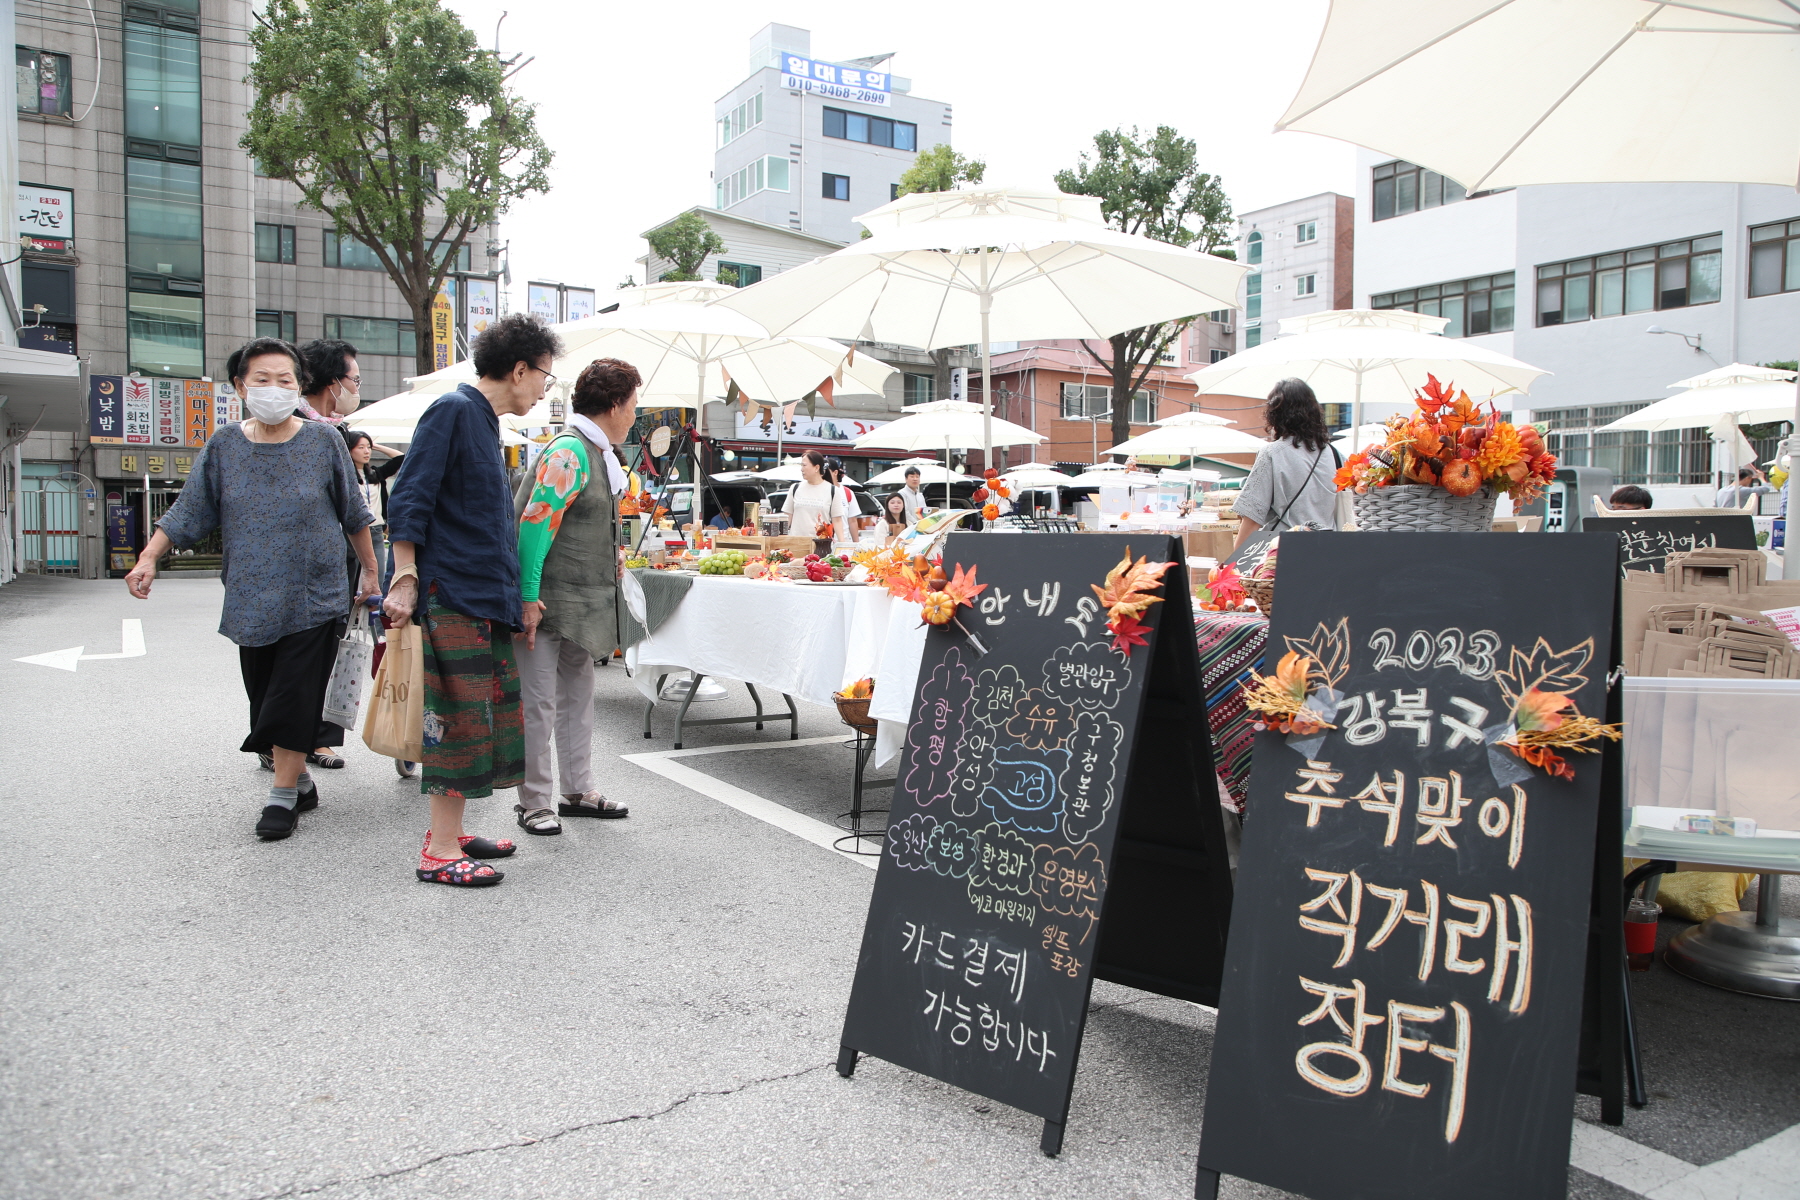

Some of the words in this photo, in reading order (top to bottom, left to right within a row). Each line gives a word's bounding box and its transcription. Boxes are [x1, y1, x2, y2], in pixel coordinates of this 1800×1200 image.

[788, 57, 885, 90] 임대문의
[788, 76, 885, 104] 010-9468-2699
[436, 312, 448, 341] 강북구
[470, 306, 493, 315] 제3회
[99, 397, 115, 431] 낮밤
[126, 411, 149, 422] 회전
[126, 424, 150, 435] 초밥
[192, 399, 209, 443] 마사지
[980, 581, 1099, 638] 안내도
[1368, 627, 1502, 681] 2023
[1059, 662, 1117, 695] 별관입구
[986, 686, 1014, 710] 김천
[928, 697, 953, 766] 함평
[1025, 704, 1059, 735] 수유
[1338, 687, 1490, 749] 강북구
[962, 735, 990, 791] 안성
[1072, 723, 1102, 818] 구청본관
[1007, 769, 1046, 803] 고성
[1284, 759, 1528, 870] 추석맞이
[903, 830, 928, 855] 익산
[940, 837, 964, 861] 보성
[981, 842, 1028, 878] 환경과
[970, 893, 993, 914] 에코
[994, 899, 1036, 927] 마일리지
[1041, 924, 1071, 951] 셀프
[1298, 866, 1533, 1016] 직거래
[901, 921, 1027, 1004] 카드결제
[1050, 951, 1083, 978] 포장
[923, 989, 1057, 1073] 가능합니다
[1295, 975, 1472, 1145] 장터
